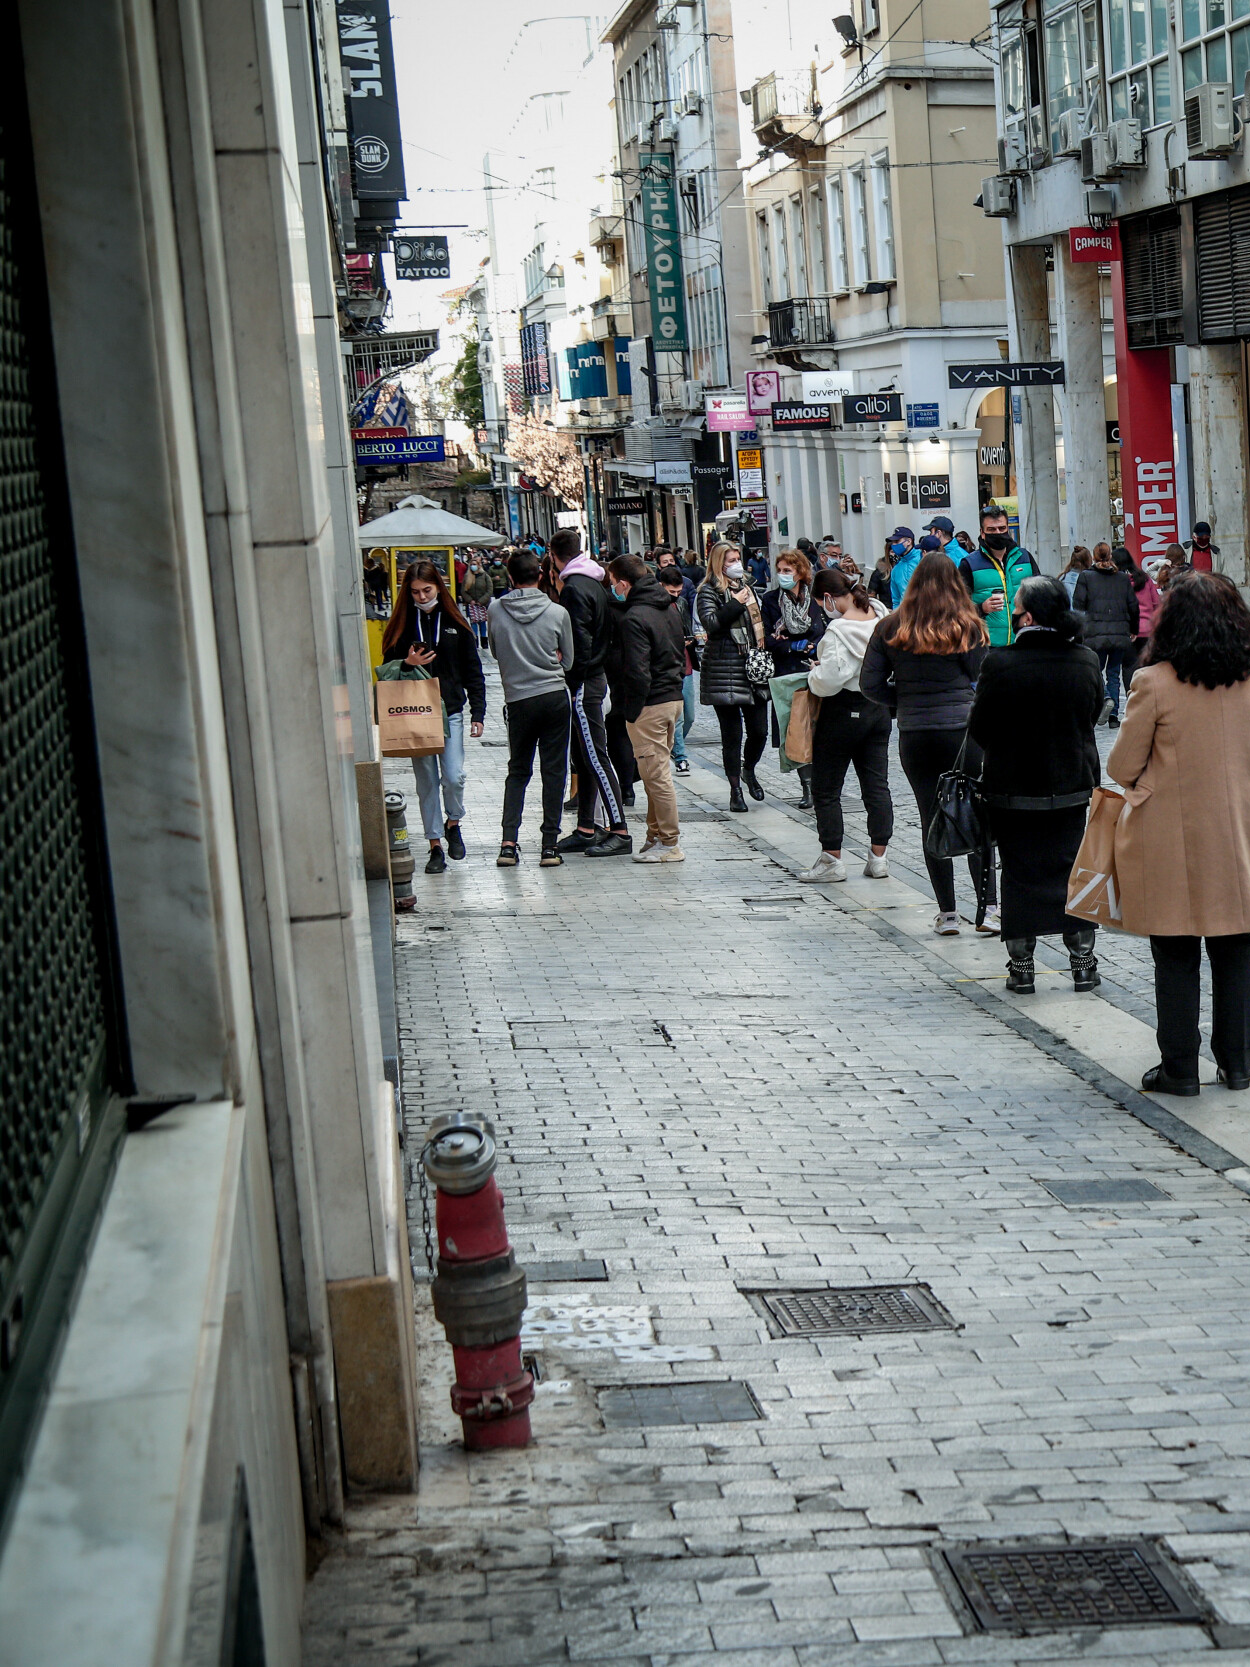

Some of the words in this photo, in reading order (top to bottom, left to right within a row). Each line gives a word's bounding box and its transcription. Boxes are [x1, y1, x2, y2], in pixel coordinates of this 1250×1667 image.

[359, 146, 381, 154] SLAM
[361, 154, 381, 163] DUNK
[1075, 236, 1112, 251] CAMPER
[650, 192, 677, 338] ΦΕΤΟΥΡΗ
[397, 267, 449, 276] TATTOO
[534, 323, 549, 383] INTERSPORT
[952, 366, 1062, 383] VANITY
[809, 388, 849, 397] avvento
[855, 396, 891, 414] alibi
[729, 412, 746, 420] SALON
[776, 407, 829, 420] FAMOUS
[403, 441, 438, 452] LUCCI
[981, 446, 1006, 465] avvent
[694, 466, 729, 474] Passager
[921, 481, 948, 495] alibi
[609, 502, 642, 510] ROMANO
[388, 706, 432, 714] COSMOS
[1067, 868, 1122, 920] ZA
